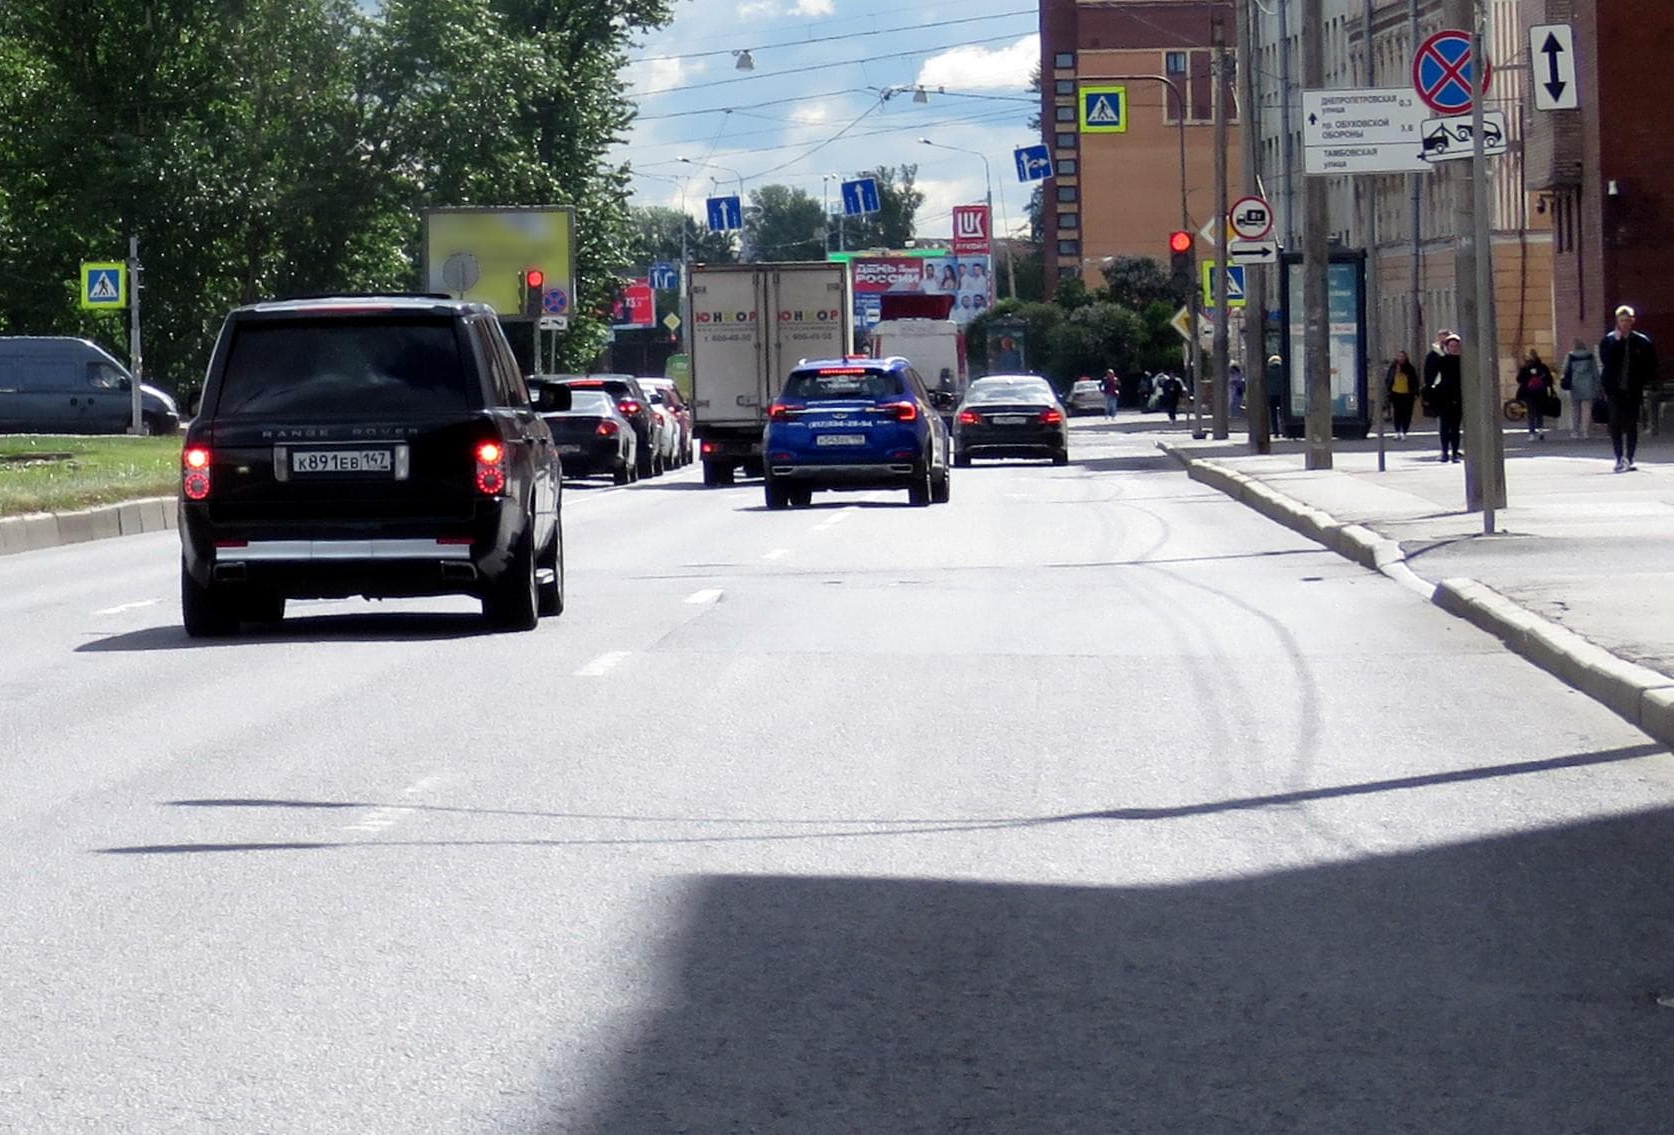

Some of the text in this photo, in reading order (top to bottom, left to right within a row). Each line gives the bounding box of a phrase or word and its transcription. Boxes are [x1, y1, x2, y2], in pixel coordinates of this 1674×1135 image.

[1321, 94, 1397, 106] ДНЕПРОПЕТРОВСКАЯ
[1322, 106, 1345, 116] улица
[1334, 117, 1390, 129] ОБУХОВСКОЙ
[1322, 130, 1364, 140] ОБОРОНЫ
[1324, 147, 1378, 158] ТАМБОВСКАЯ
[1324, 160, 1347, 170] улица
[854, 273, 920, 285] РОССИИ
[261, 426, 419, 439] RANGE ROVER
[362, 452, 386, 465] 147
